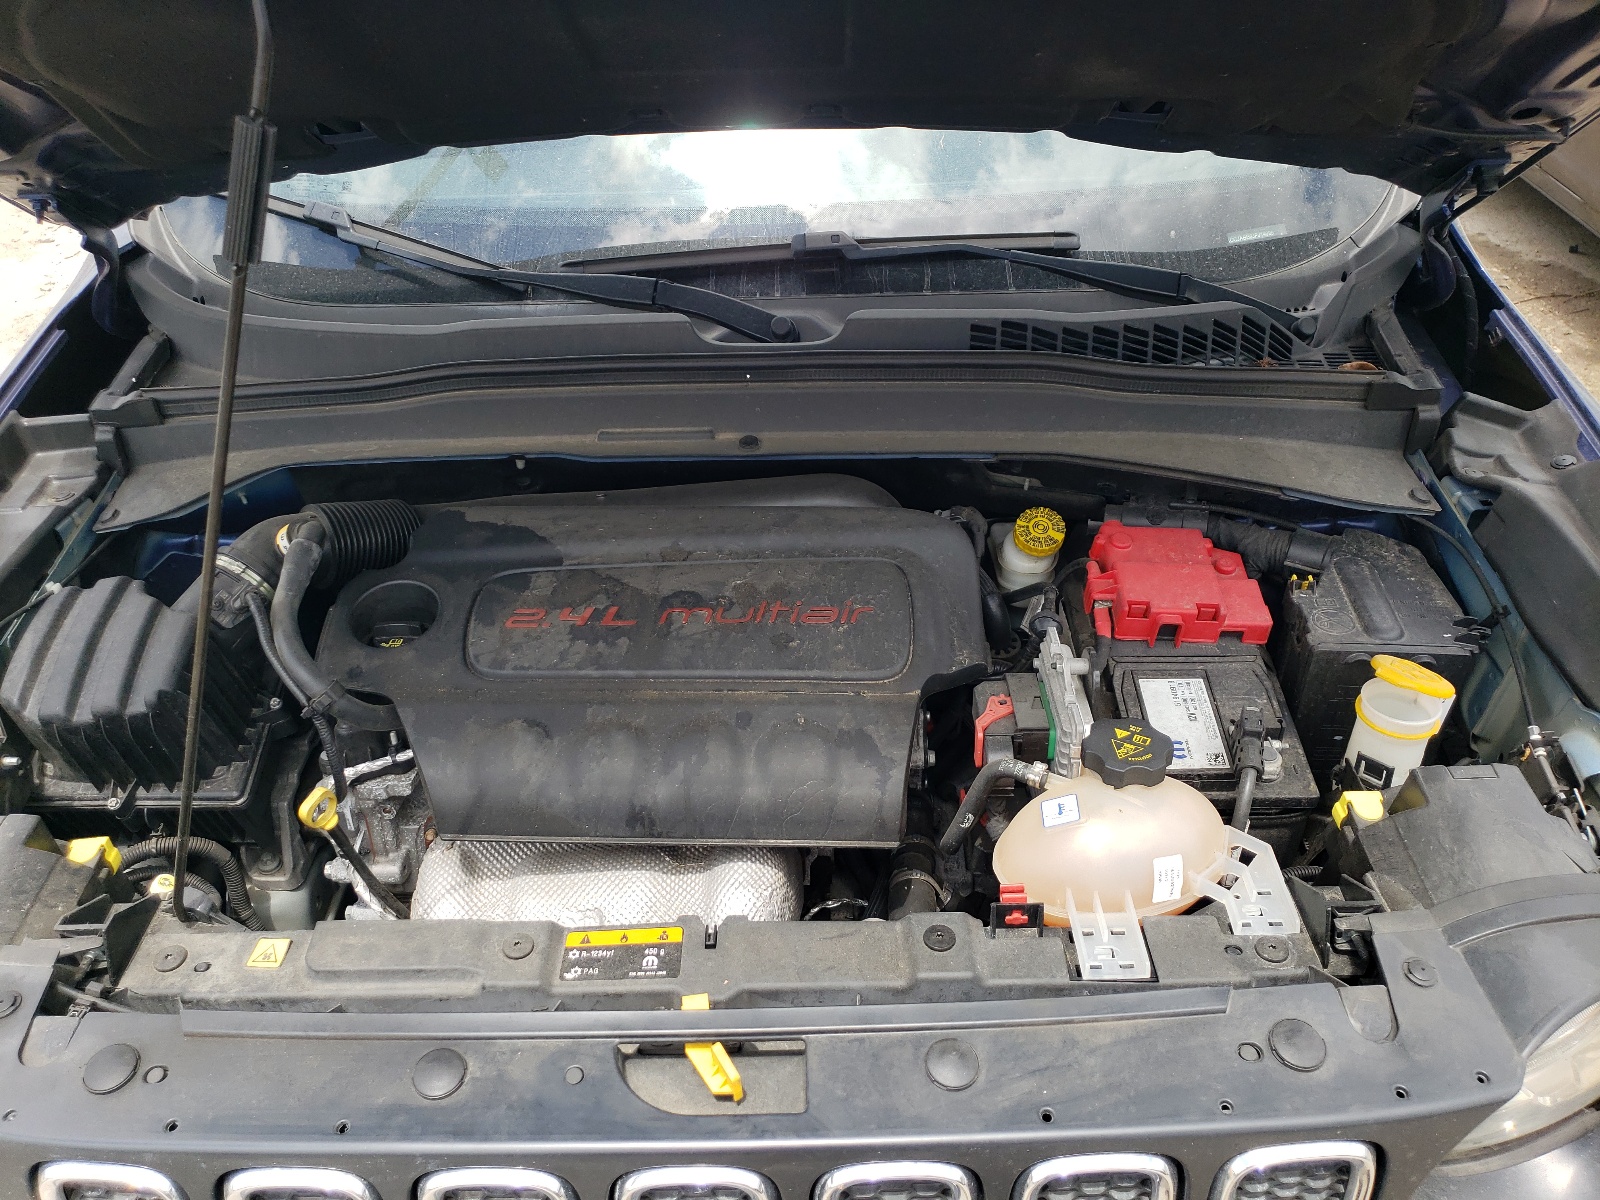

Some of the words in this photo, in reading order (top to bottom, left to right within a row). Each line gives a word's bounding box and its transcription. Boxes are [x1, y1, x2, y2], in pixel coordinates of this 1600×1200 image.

[658, 599, 874, 626] multiair
[644, 947, 658, 955] 450
[583, 967, 599, 975] PAG
